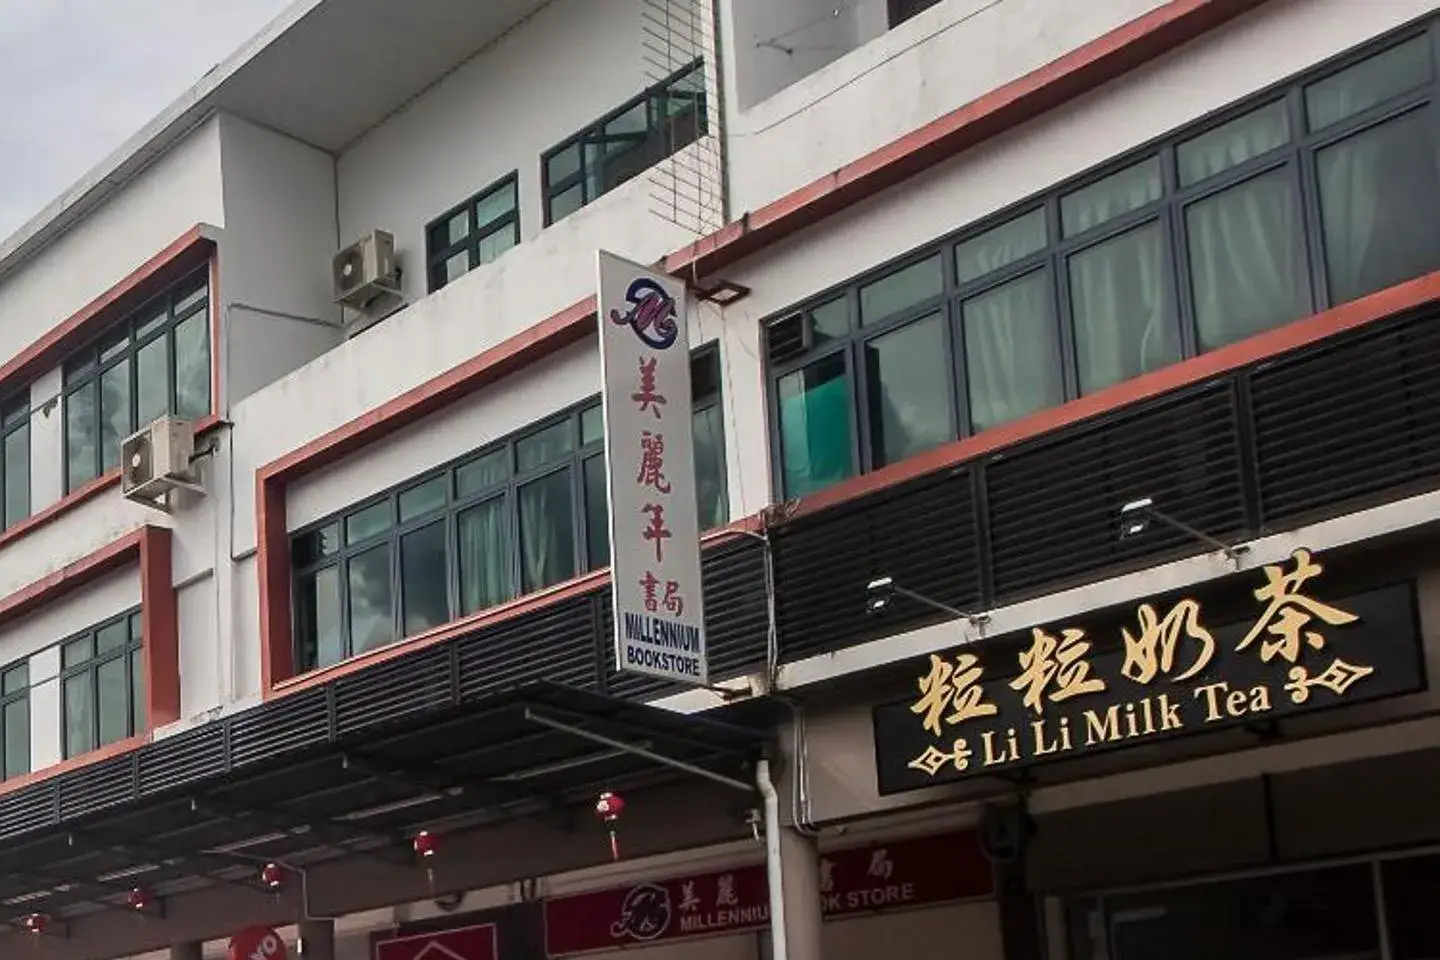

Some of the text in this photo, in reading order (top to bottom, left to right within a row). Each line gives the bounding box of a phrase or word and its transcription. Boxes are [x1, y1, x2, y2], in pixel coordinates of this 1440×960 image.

[624, 611, 700, 653] MILLENNIUM
[909, 547, 1359, 737] 粒粒奶茶
[626, 644, 701, 677] BOOKSTORE
[982, 680, 1272, 768] Li Li Milk Tea
[679, 903, 769, 932] MILLENNIU
[847, 881, 916, 908] STORE
